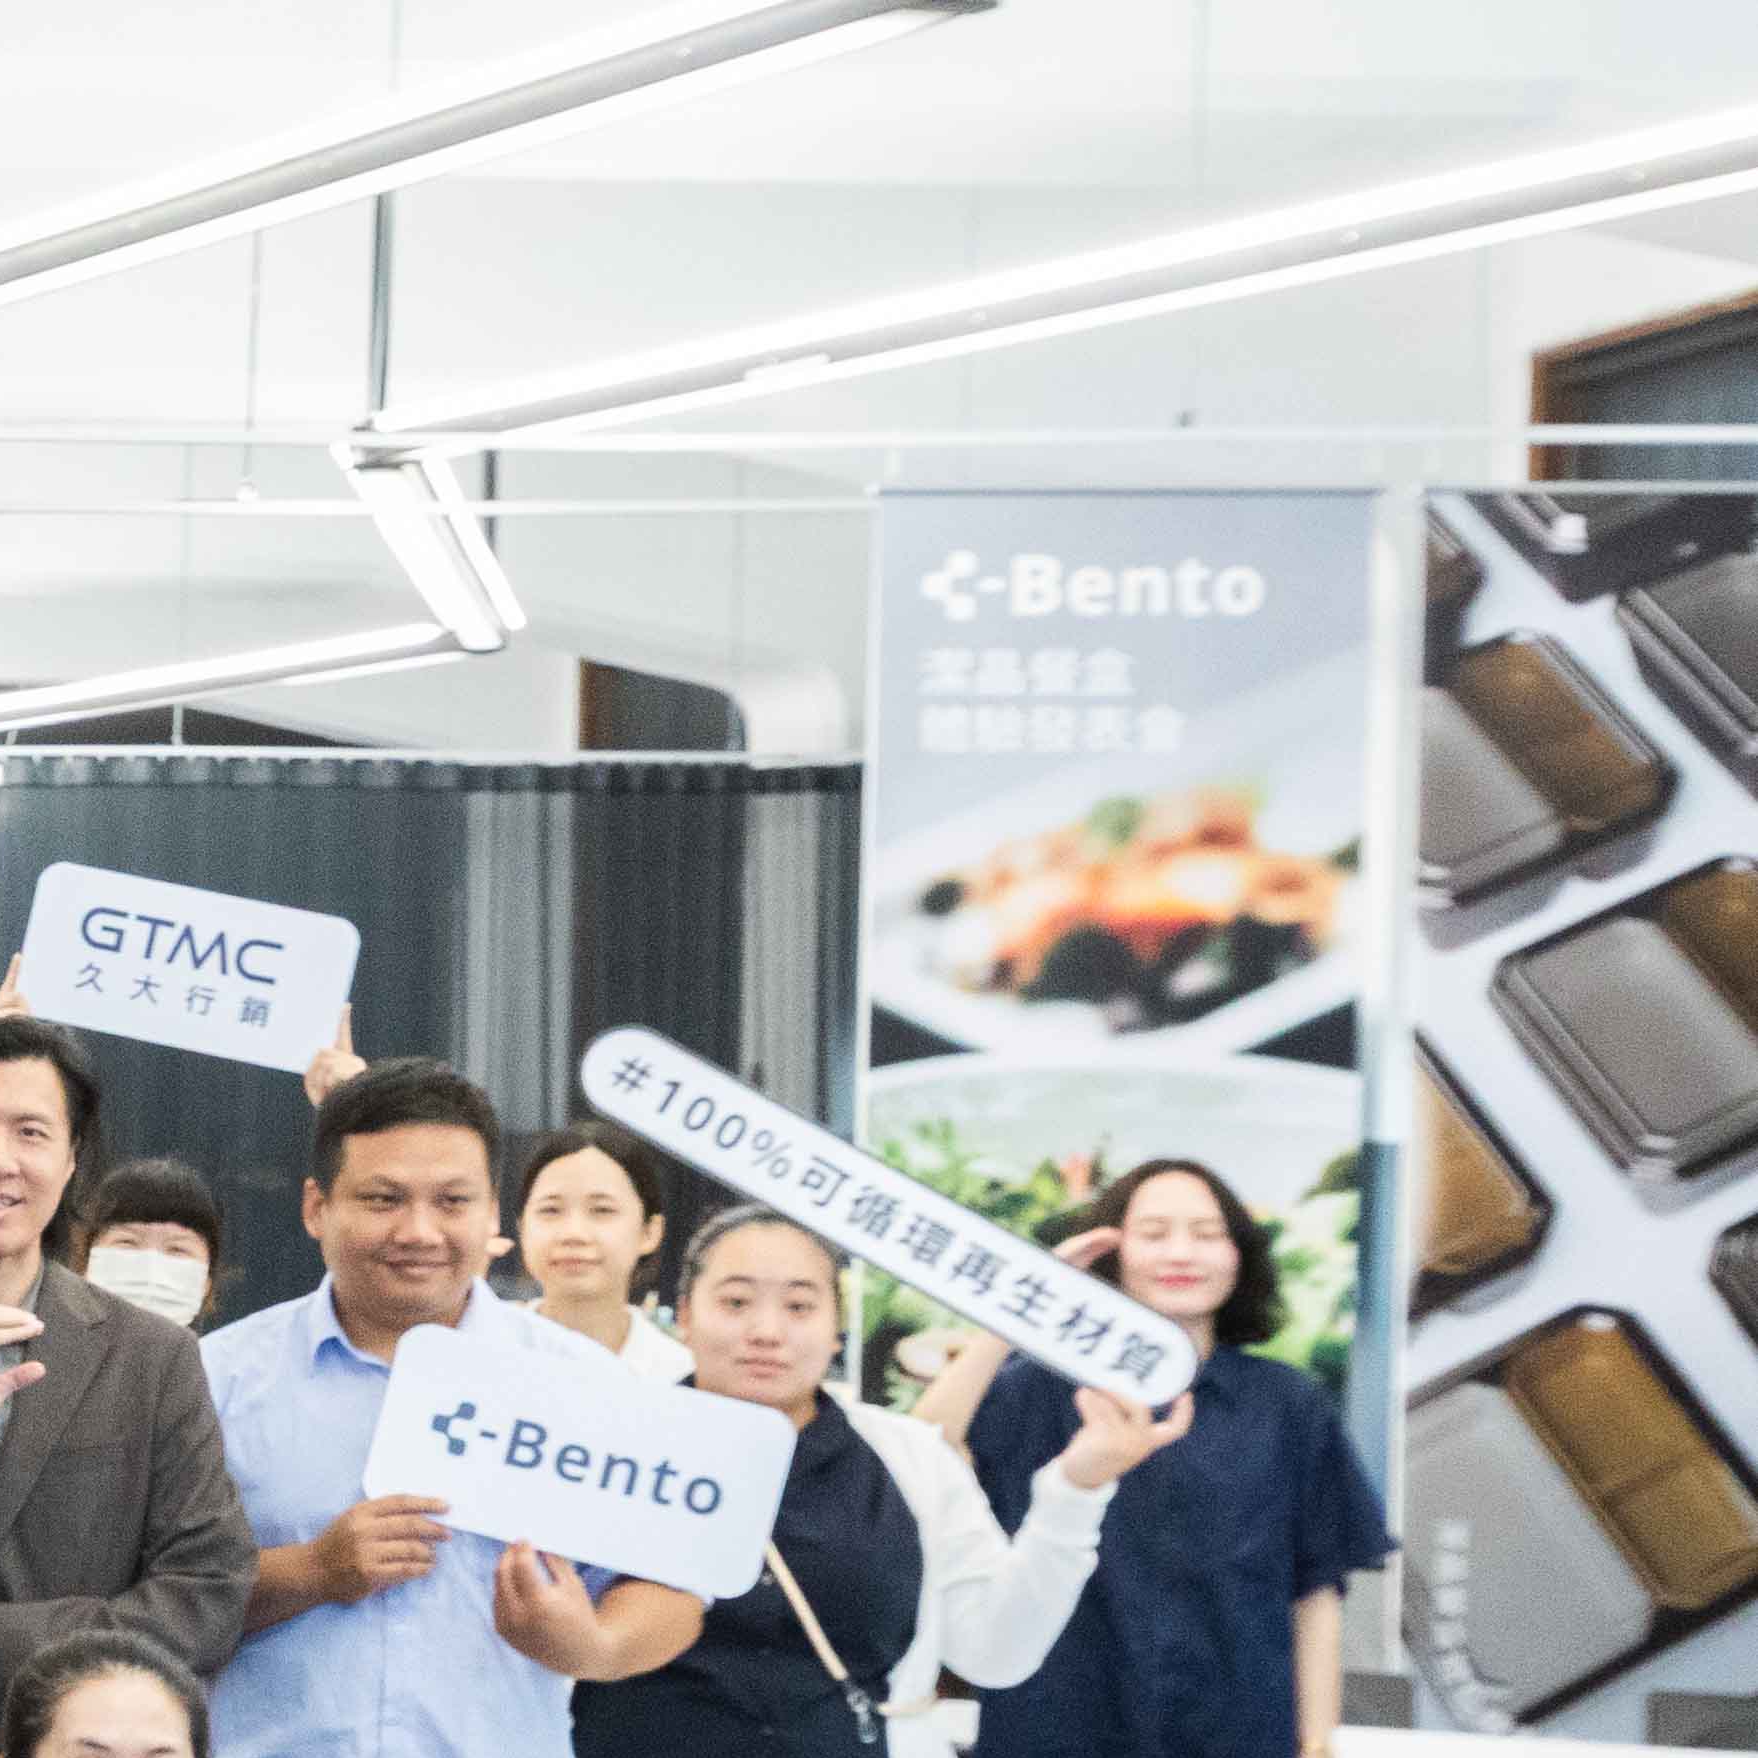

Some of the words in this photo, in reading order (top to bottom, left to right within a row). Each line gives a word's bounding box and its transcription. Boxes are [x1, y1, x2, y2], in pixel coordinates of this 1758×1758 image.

[81, 906, 285, 985] GTMC
[75, 962, 272, 1029] 久大行銷
[611, 1055, 1169, 1388] #100%可循環再生材質
